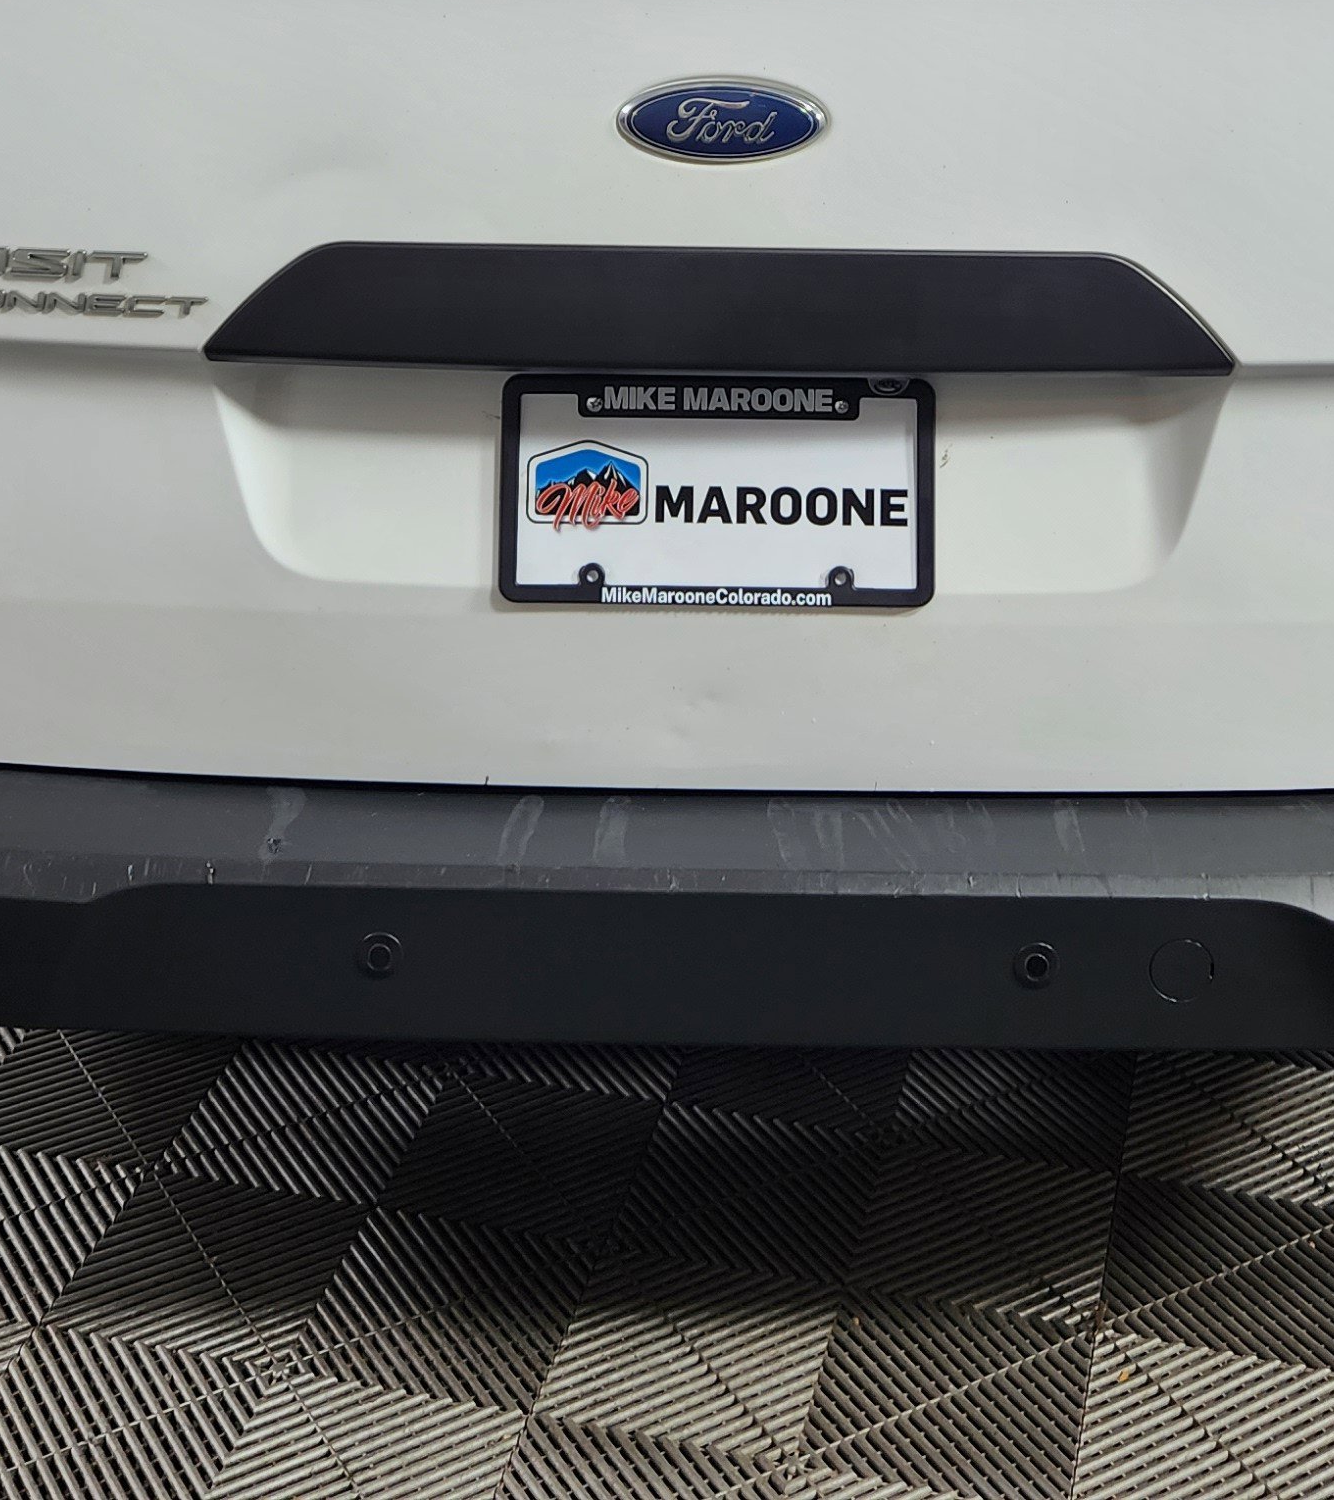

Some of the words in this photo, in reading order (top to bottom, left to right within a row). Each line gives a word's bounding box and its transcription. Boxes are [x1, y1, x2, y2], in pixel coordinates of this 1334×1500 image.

[667, 97, 778, 144] Ford
[604, 386, 675, 411] MIKE
[683, 387, 833, 414] MAROONE
[536, 478, 640, 532] Mike
[655, 485, 909, 527] MAROONE
[601, 586, 832, 607] MikeMarooneColorado.com
